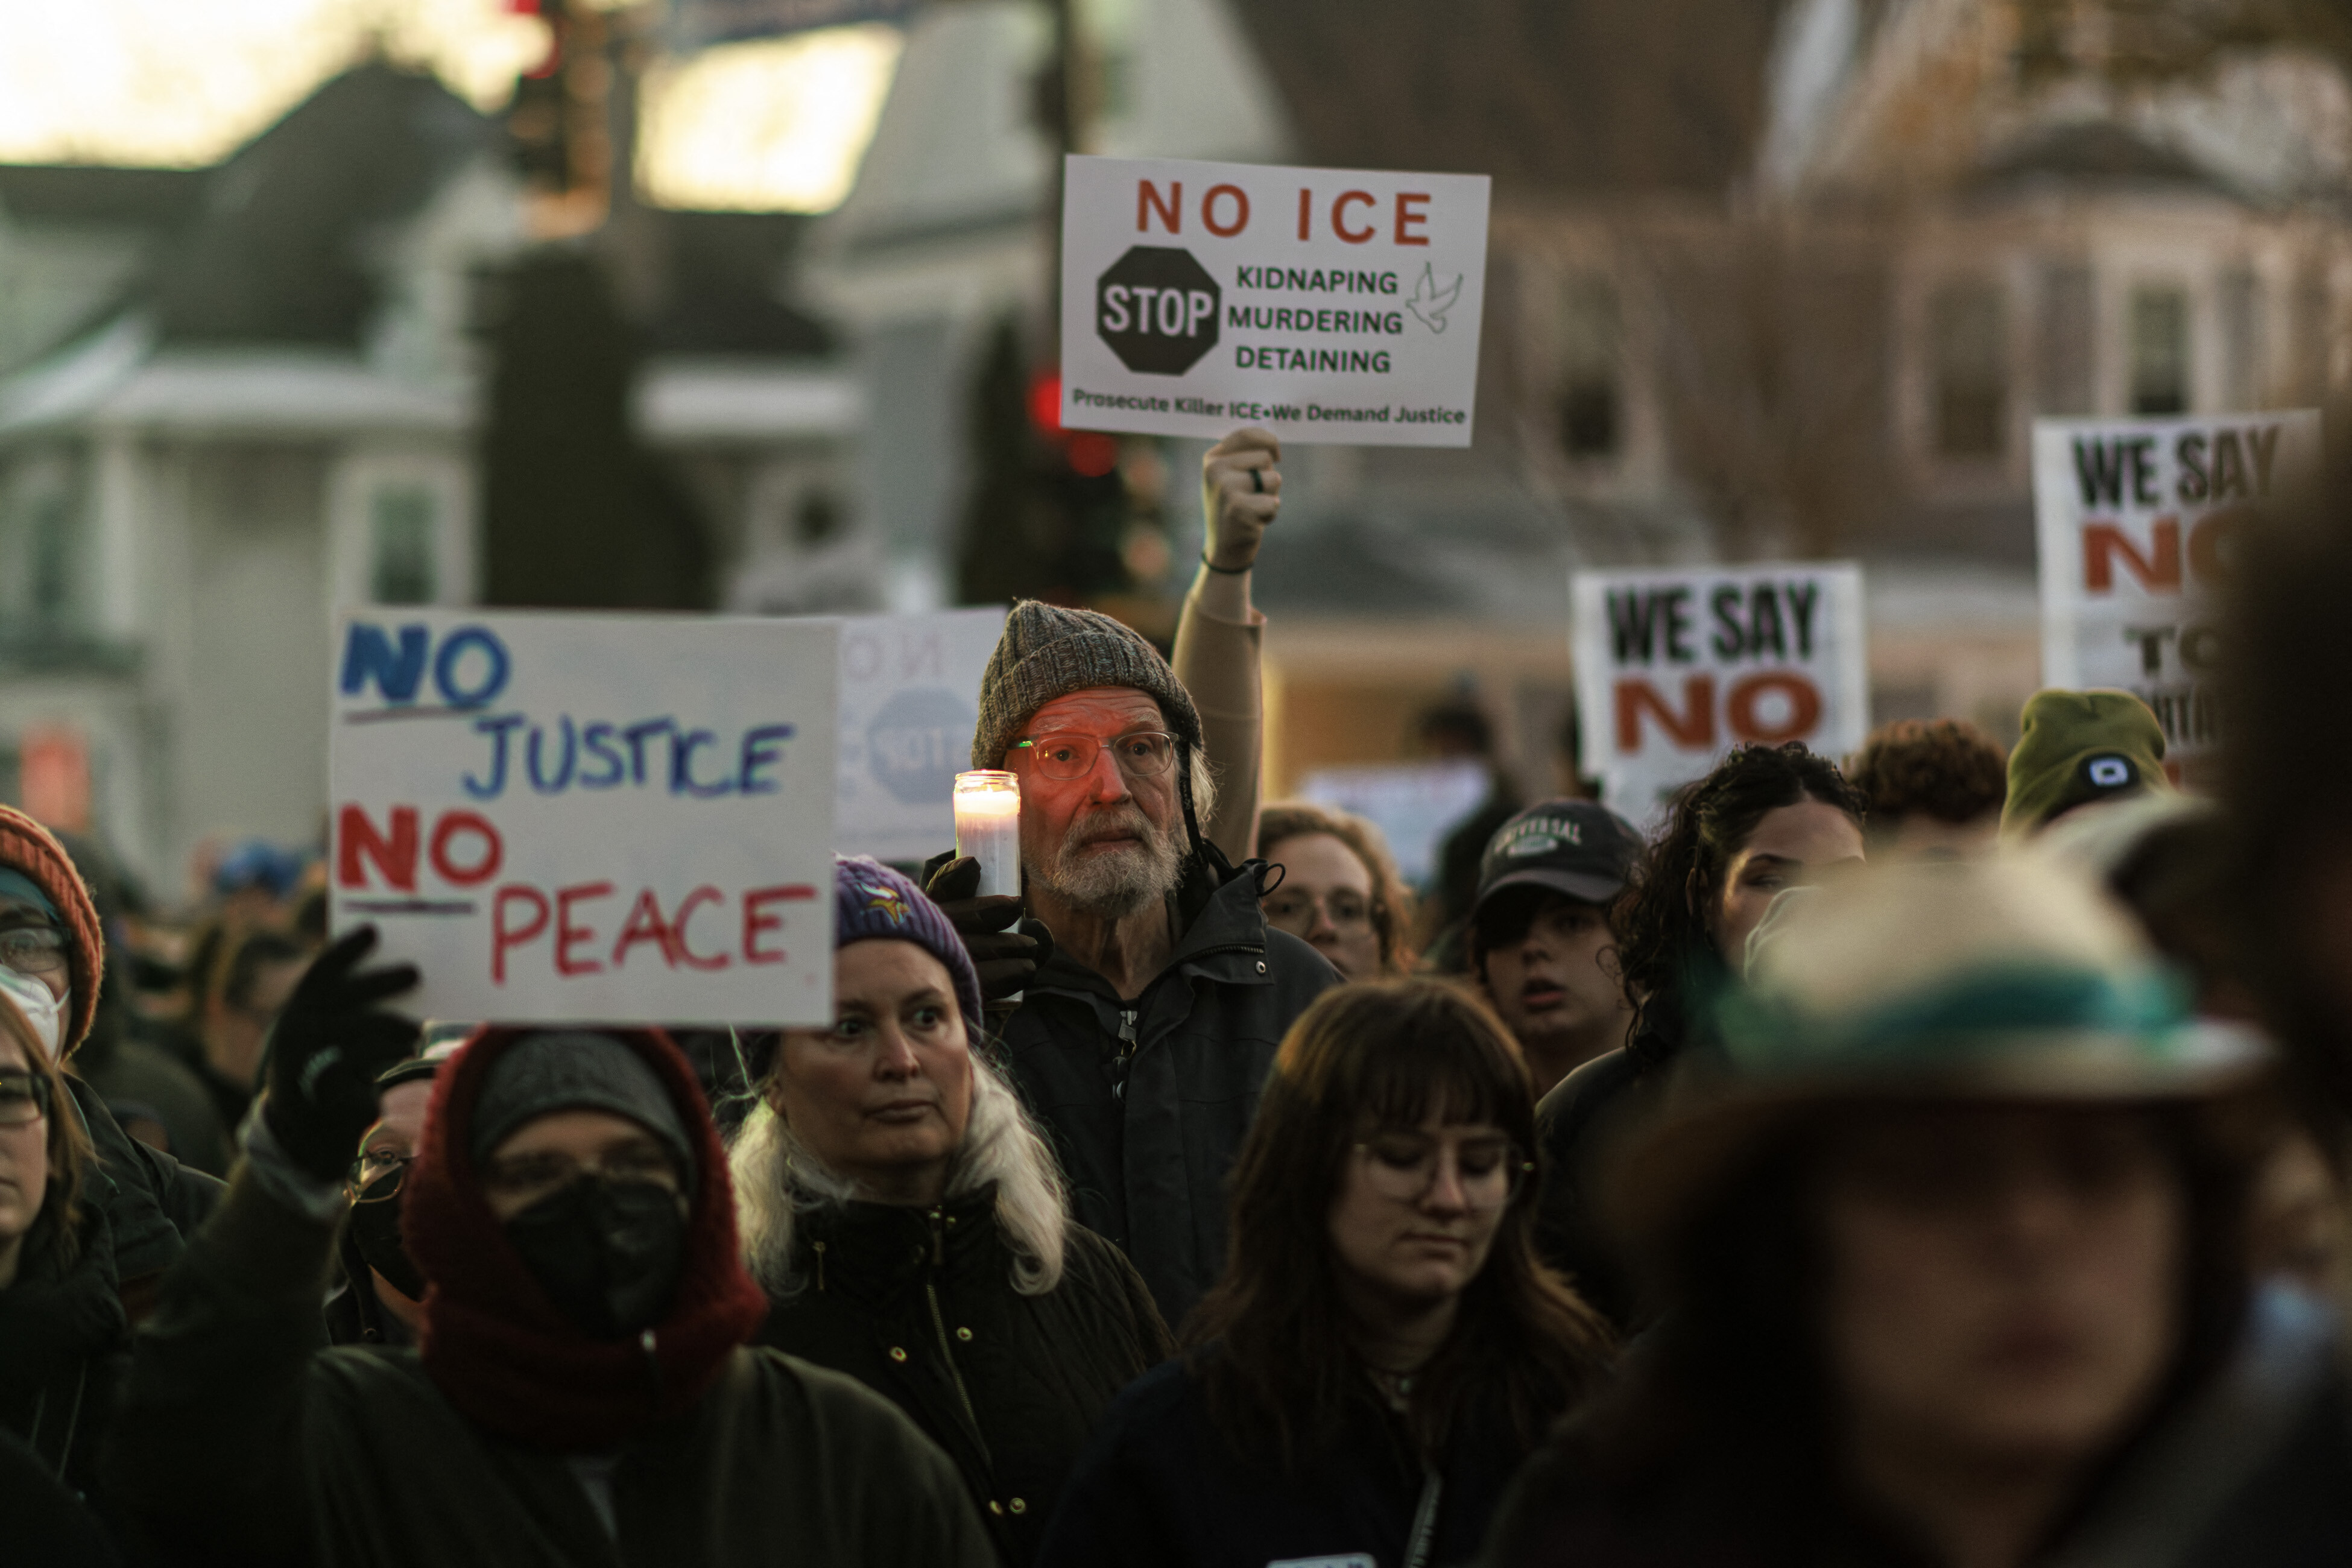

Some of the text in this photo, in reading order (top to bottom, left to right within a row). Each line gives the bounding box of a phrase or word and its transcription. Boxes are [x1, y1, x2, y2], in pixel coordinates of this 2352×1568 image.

[1137, 179, 1432, 246] NO ICE
[1102, 285, 1213, 337] STOP
[1228, 305, 1403, 334] MURDERING
[1237, 265, 1398, 294] KIDNAPING
[1236, 346, 1390, 373] DETAINING
[1073, 388, 1169, 412] Prosecute
[1175, 397, 1224, 416] Killer
[1307, 403, 1389, 422] Demand
[1394, 407, 1465, 423] Justice
[2075, 425, 2280, 510] WE SAY
[340, 622, 513, 706] NO
[1606, 579, 1817, 665] WE SAY
[1613, 671, 1822, 757] NO
[463, 713, 794, 800] JUSTICE
[338, 803, 504, 893] NO
[491, 880, 817, 985] PEACE
